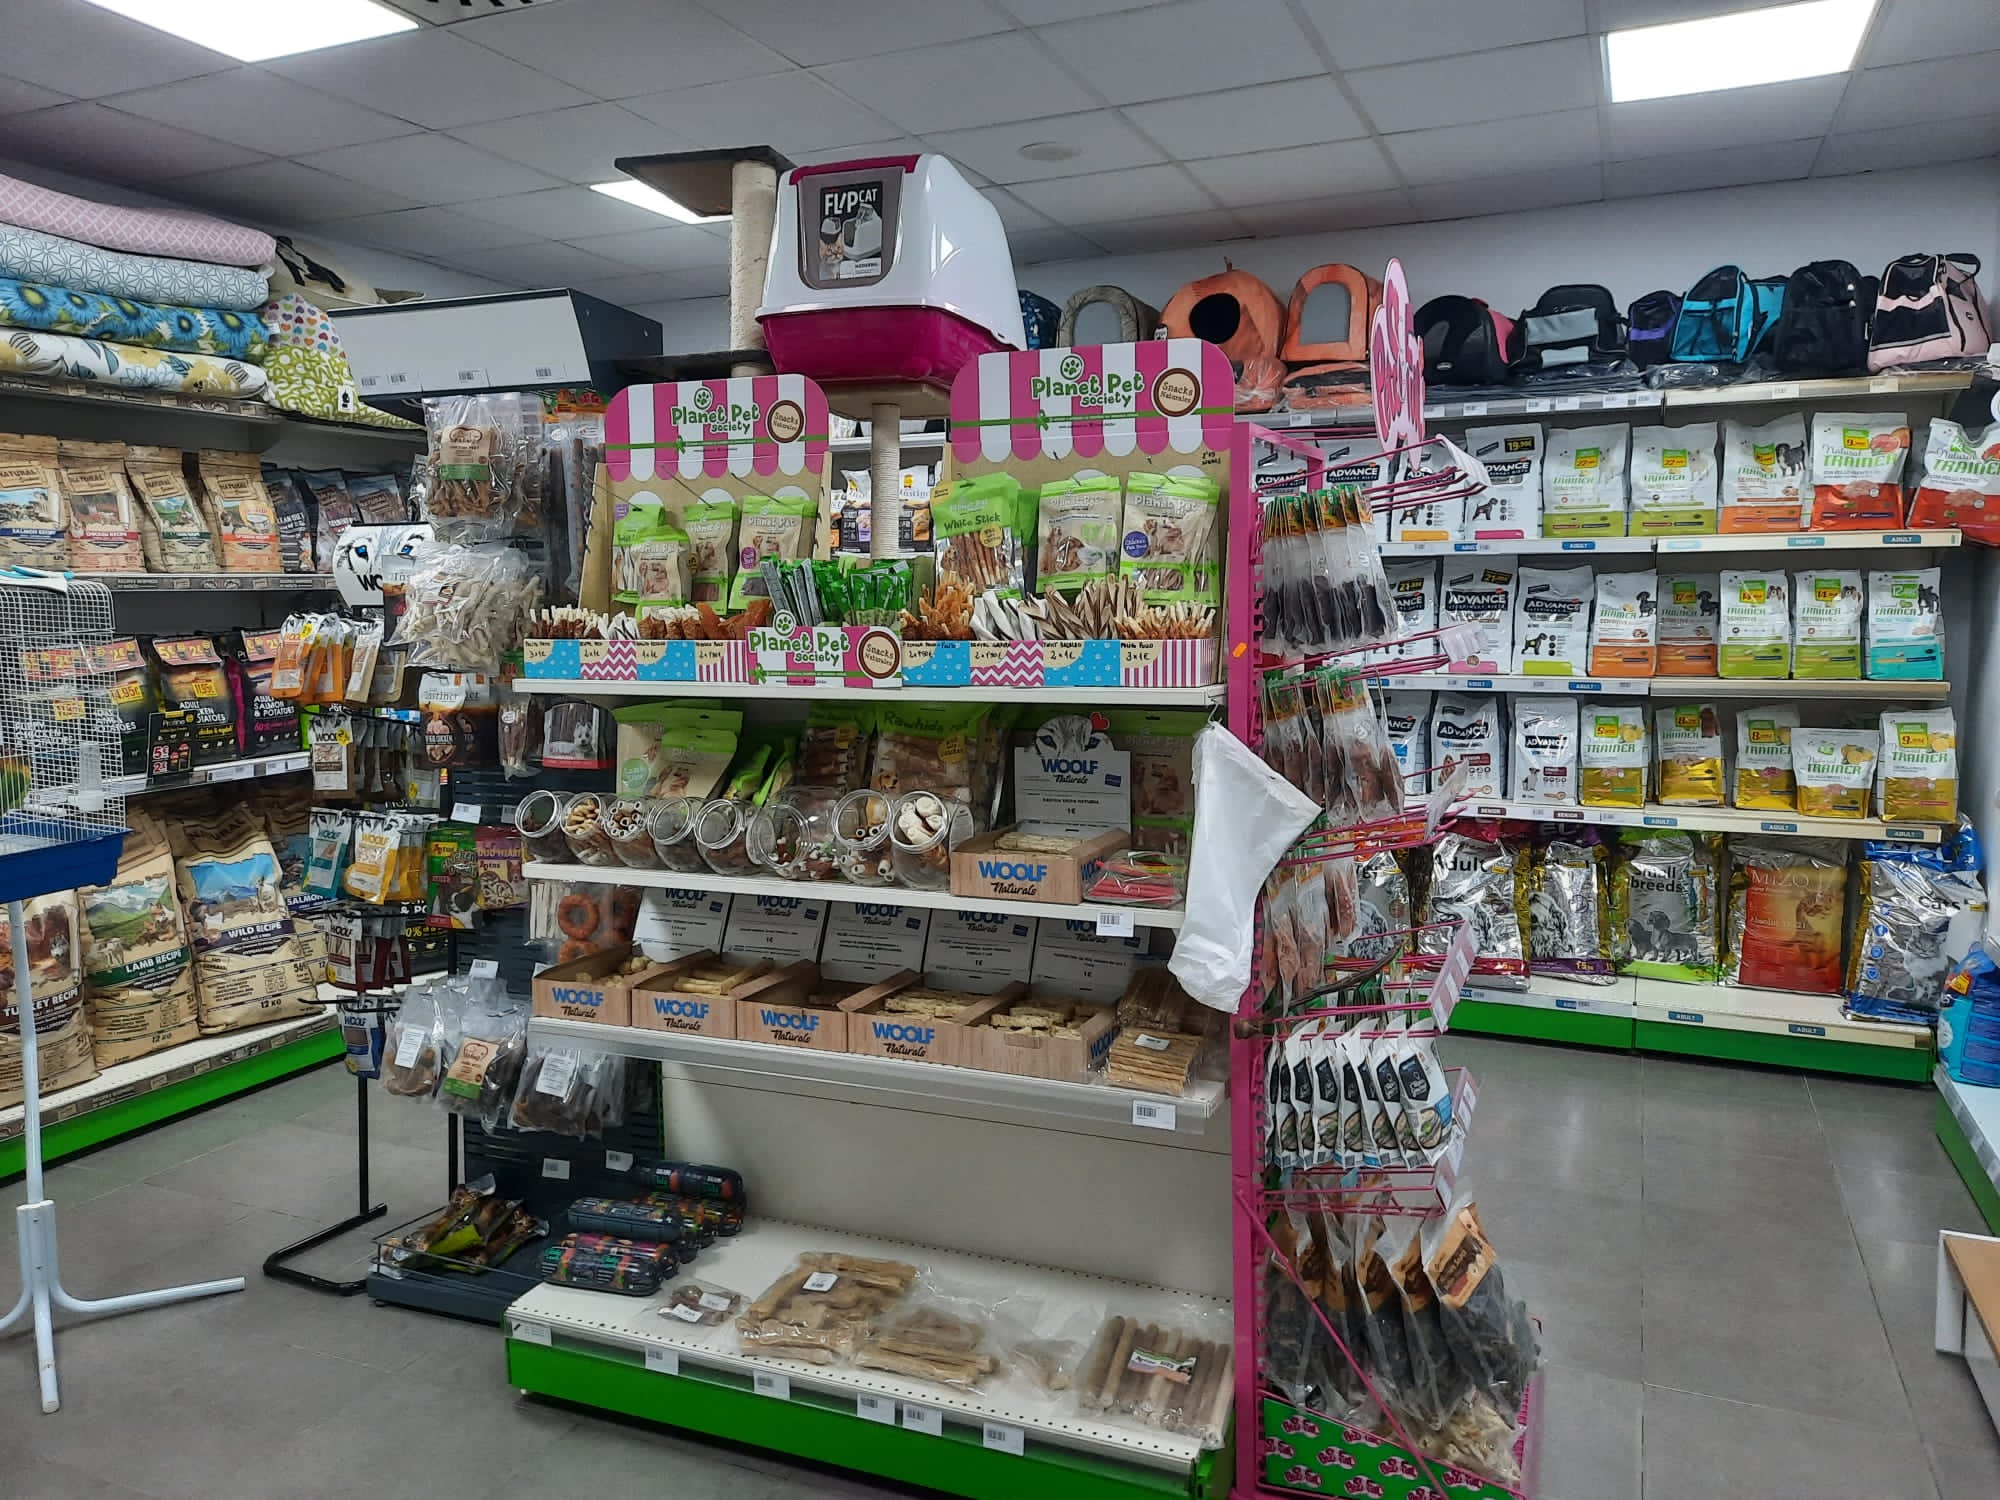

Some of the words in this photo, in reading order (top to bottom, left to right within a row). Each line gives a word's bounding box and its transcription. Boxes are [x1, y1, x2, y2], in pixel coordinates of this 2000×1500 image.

[825, 191, 858, 216] FLIP
[860, 188, 877, 202] CAT
[1032, 376, 1100, 398] Planet
[1107, 372, 1144, 393] Pet
[1162, 381, 1194, 395] Snacks
[1080, 393, 1131, 407] society
[672, 405, 726, 425] Planet
[731, 404, 760, 422] Pet
[774, 411, 799, 424] Snacks
[711, 422, 750, 433] society
[1486, 463, 1529, 472] DVANCE
[1823, 454, 1897, 467] TRAINER
[1330, 468, 1378, 477] ADVANCE
[944, 518, 973, 530] White
[975, 512, 1001, 525] Stick
[1398, 597, 1422, 606] ANCE
[1450, 593, 1506, 604] ADVANCE
[1528, 601, 1579, 611] ADVANCE
[749, 632, 812, 652] Planet
[817, 631, 850, 652] Pet
[795, 651, 840, 666] society
[866, 643, 895, 659] Snacks
[1440, 726, 1487, 737] ADVANCE
[1587, 744, 1635, 753] TRAINER
[1891, 751, 1949, 763] TRAINER
[1042, 758, 1099, 775] WOOLF
[1807, 763, 1862, 775] TRAINER
[1053, 775, 1088, 784] Naturals
[979, 859, 1047, 882] WOOLF
[1435, 854, 1487, 872] Adult
[991, 881, 1037, 896] Naturals
[1631, 877, 1680, 893] breeds
[664, 888, 708, 901] WOOLF
[757, 895, 802, 909] WOOLF
[855, 903, 903, 917] WOOLF
[958, 910, 1009, 924] WOOLF
[229, 925, 255, 939] WILD
[255, 921, 282, 935] RECIPE
[126, 957, 155, 974] LAMB
[156, 950, 182, 967] RECIPE
[52, 988, 79, 1006] RECIPE
[552, 987, 604, 1007] WOOLF
[560, 1005, 597, 1019] Naturals
[654, 998, 709, 1020] WOOLF
[664, 1017, 701, 1032] Naturals
[760, 1009, 820, 1032] WOOLF
[771, 1029, 812, 1044] Naturals
[872, 1021, 936, 1045] WOOLF
[883, 1042, 927, 1058] Naturals
